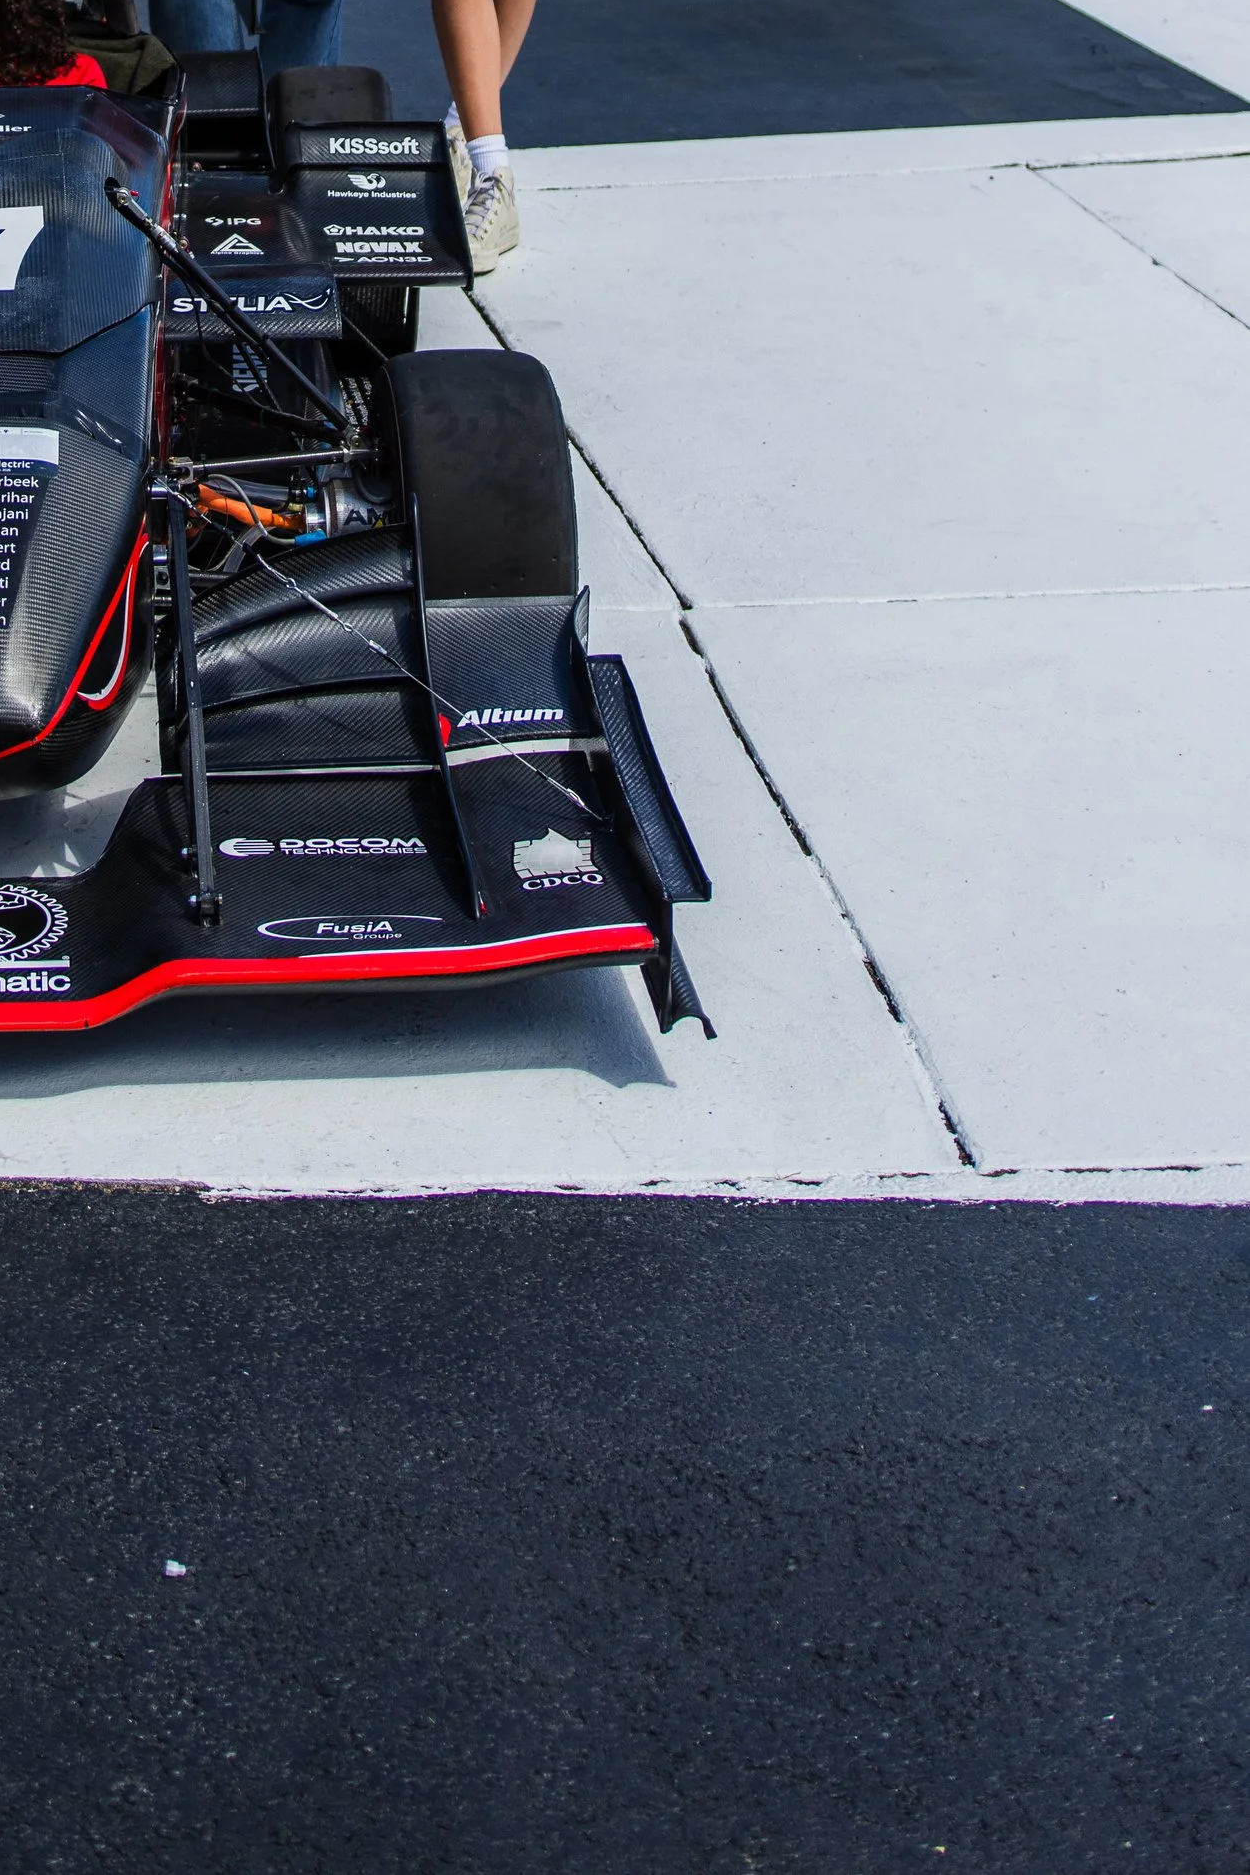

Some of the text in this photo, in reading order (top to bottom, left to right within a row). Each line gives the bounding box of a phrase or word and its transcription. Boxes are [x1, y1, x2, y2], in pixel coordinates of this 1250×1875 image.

[329, 136, 420, 155] KISSsoft
[327, 190, 417, 199] Hawkeye Industries
[227, 217, 261, 226] IPG
[345, 225, 424, 236] HAKKO
[336, 241, 423, 254] NOVAX
[457, 708, 563, 727] Altium
[280, 838, 424, 847] DOCOM
[523, 873, 604, 891] CDCQ
[317, 921, 393, 934] FusiA
